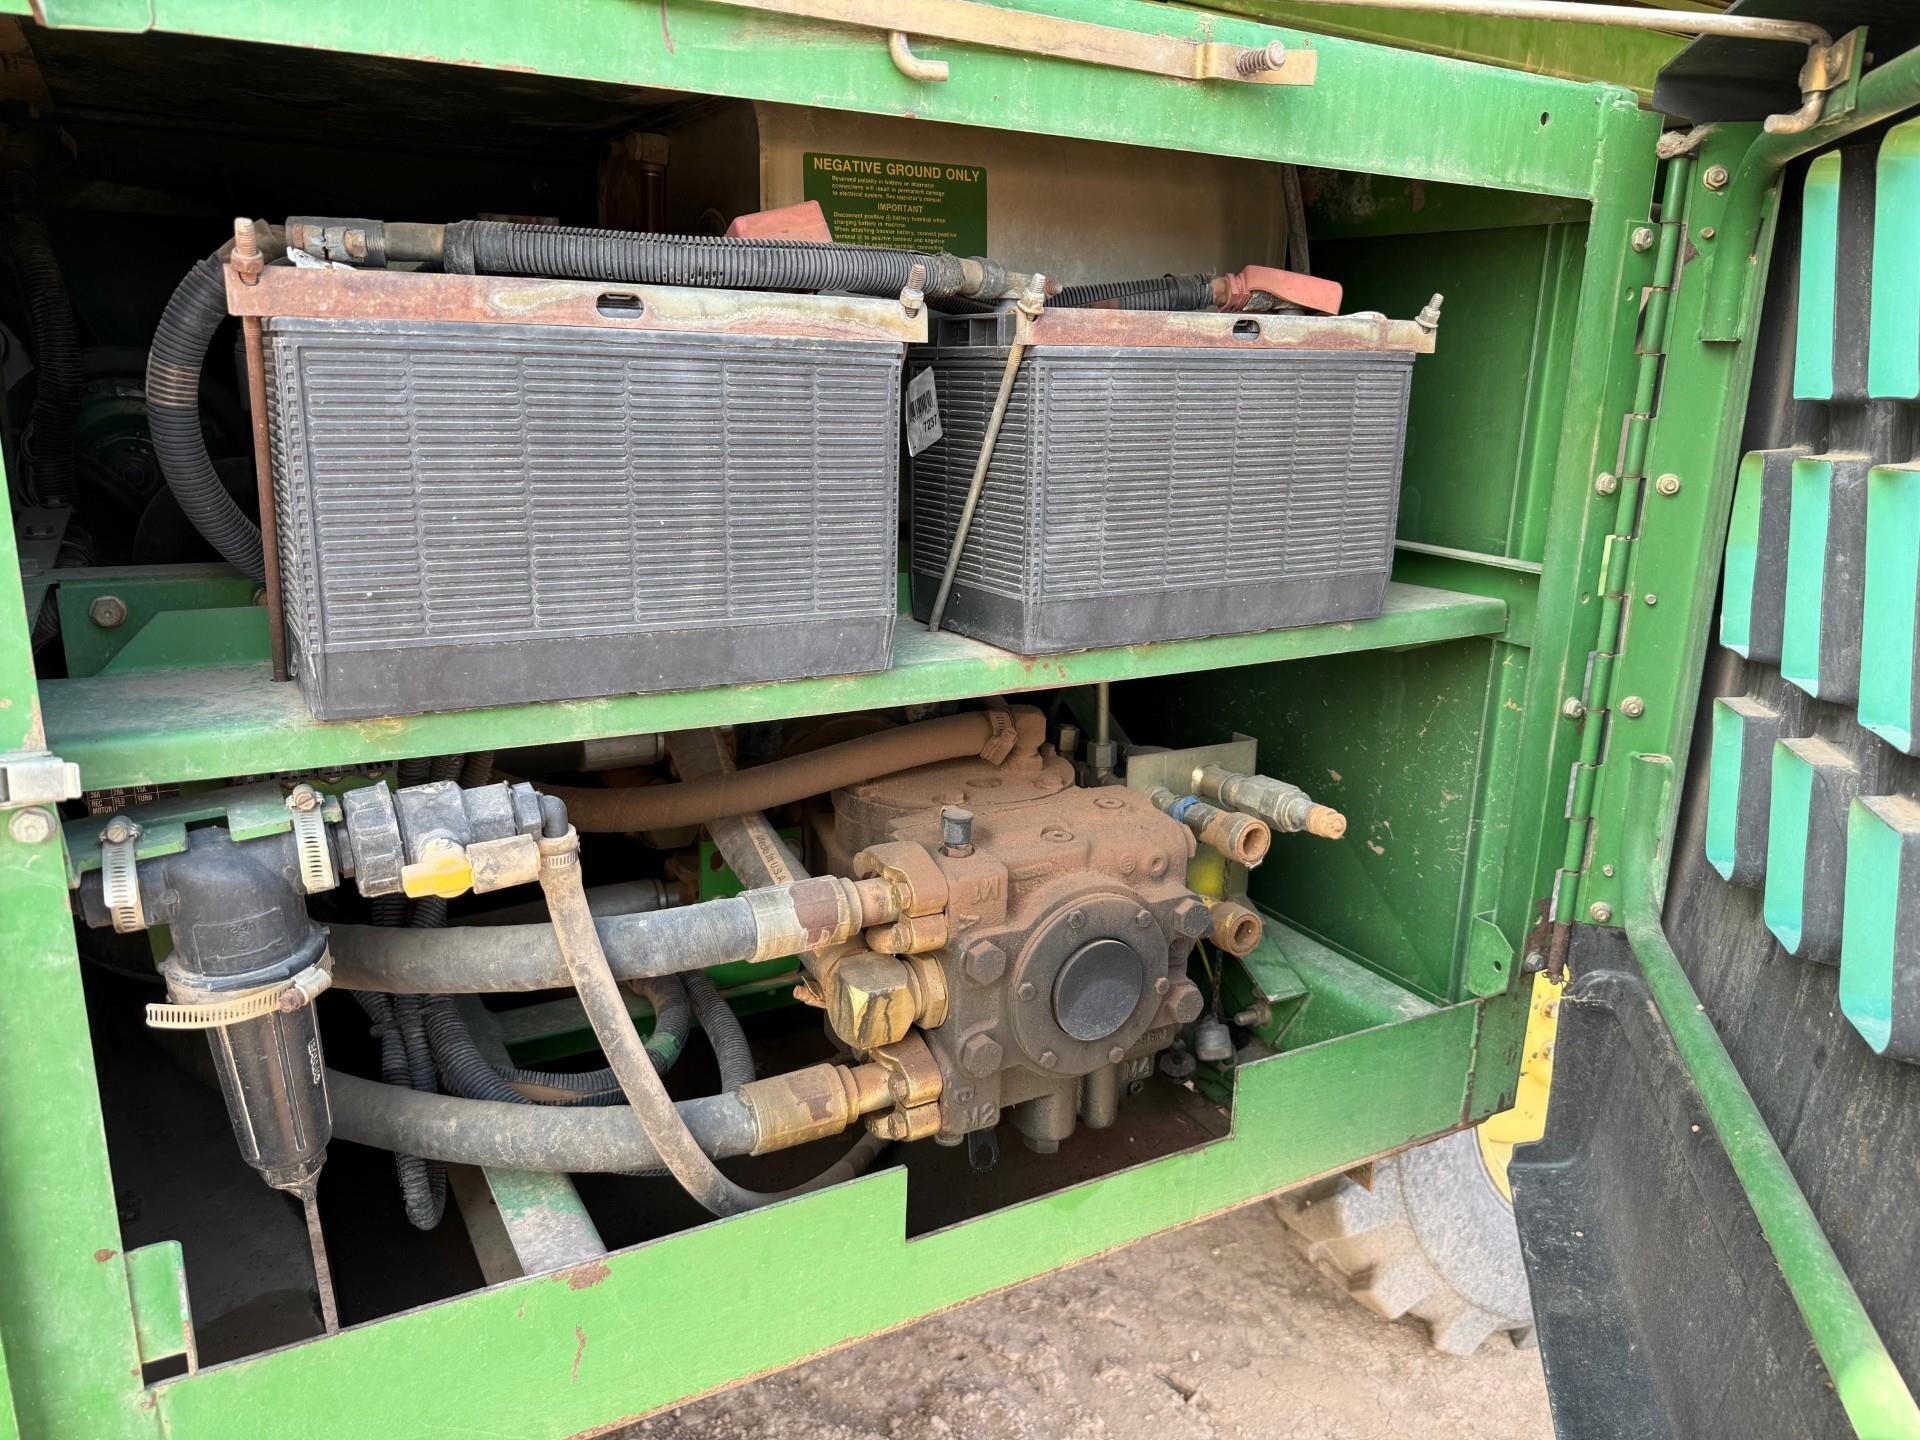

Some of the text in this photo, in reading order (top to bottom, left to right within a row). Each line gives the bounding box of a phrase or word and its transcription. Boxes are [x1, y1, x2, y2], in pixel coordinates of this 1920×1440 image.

[813, 156, 980, 183] NEGATIVE GROUND ONLY
[833, 211, 863, 219] Disconnect
[877, 202, 923, 213] IMPORTANT
[923, 414, 938, 433] 7237
[92, 806, 113, 814] MOTOR
[1126, 1055, 1152, 1080] M4
[961, 1101, 997, 1129] M2
